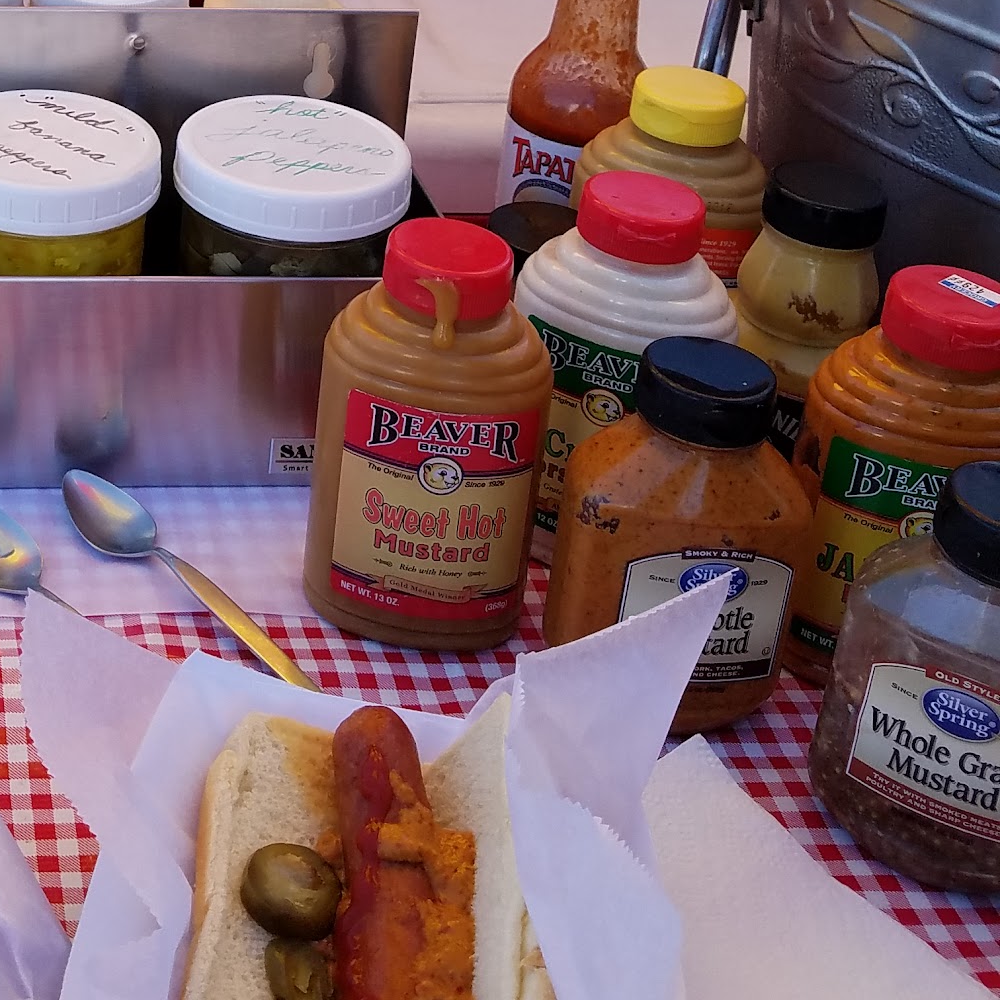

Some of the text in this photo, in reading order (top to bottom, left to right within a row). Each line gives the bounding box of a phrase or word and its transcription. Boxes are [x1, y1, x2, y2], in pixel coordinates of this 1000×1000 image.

[582, 371, 634, 393] BRAND
[366, 402, 520, 463] BEAVER
[418, 441, 470, 457] BRAND
[282, 464, 309, 472] Smart
[367, 462, 415, 481] The Original
[464, 480, 486, 488] Since
[362, 487, 507, 540] Sweet Hot
[843, 512, 894, 534] The Original
[373, 528, 490, 562] Mustard
[399, 563, 463, 578] Rich with Honey
[649, 574, 676, 584] SINCE
[340, 579, 400, 606] NET WT. 13 OZ.
[389, 579, 466, 601] Gold Medal Winner
[801, 629, 817, 642] NET
[891, 682, 918, 700] SINCE
[935, 671, 1000, 702] OLD STYLE
[936, 691, 988, 721] Silver
[928, 701, 990, 738] Spring
[872, 705, 951, 766] Whole
[886, 747, 999, 812] Mustard
[866, 776, 905, 800] POULTRY
[907, 797, 927, 810] AND
[928, 807, 961, 824] SHARP
[872, 772, 890, 785] TRY
[892, 781, 901, 791] IT
[903, 788, 926, 803] WITH
[929, 800, 968, 820] SMOKED
